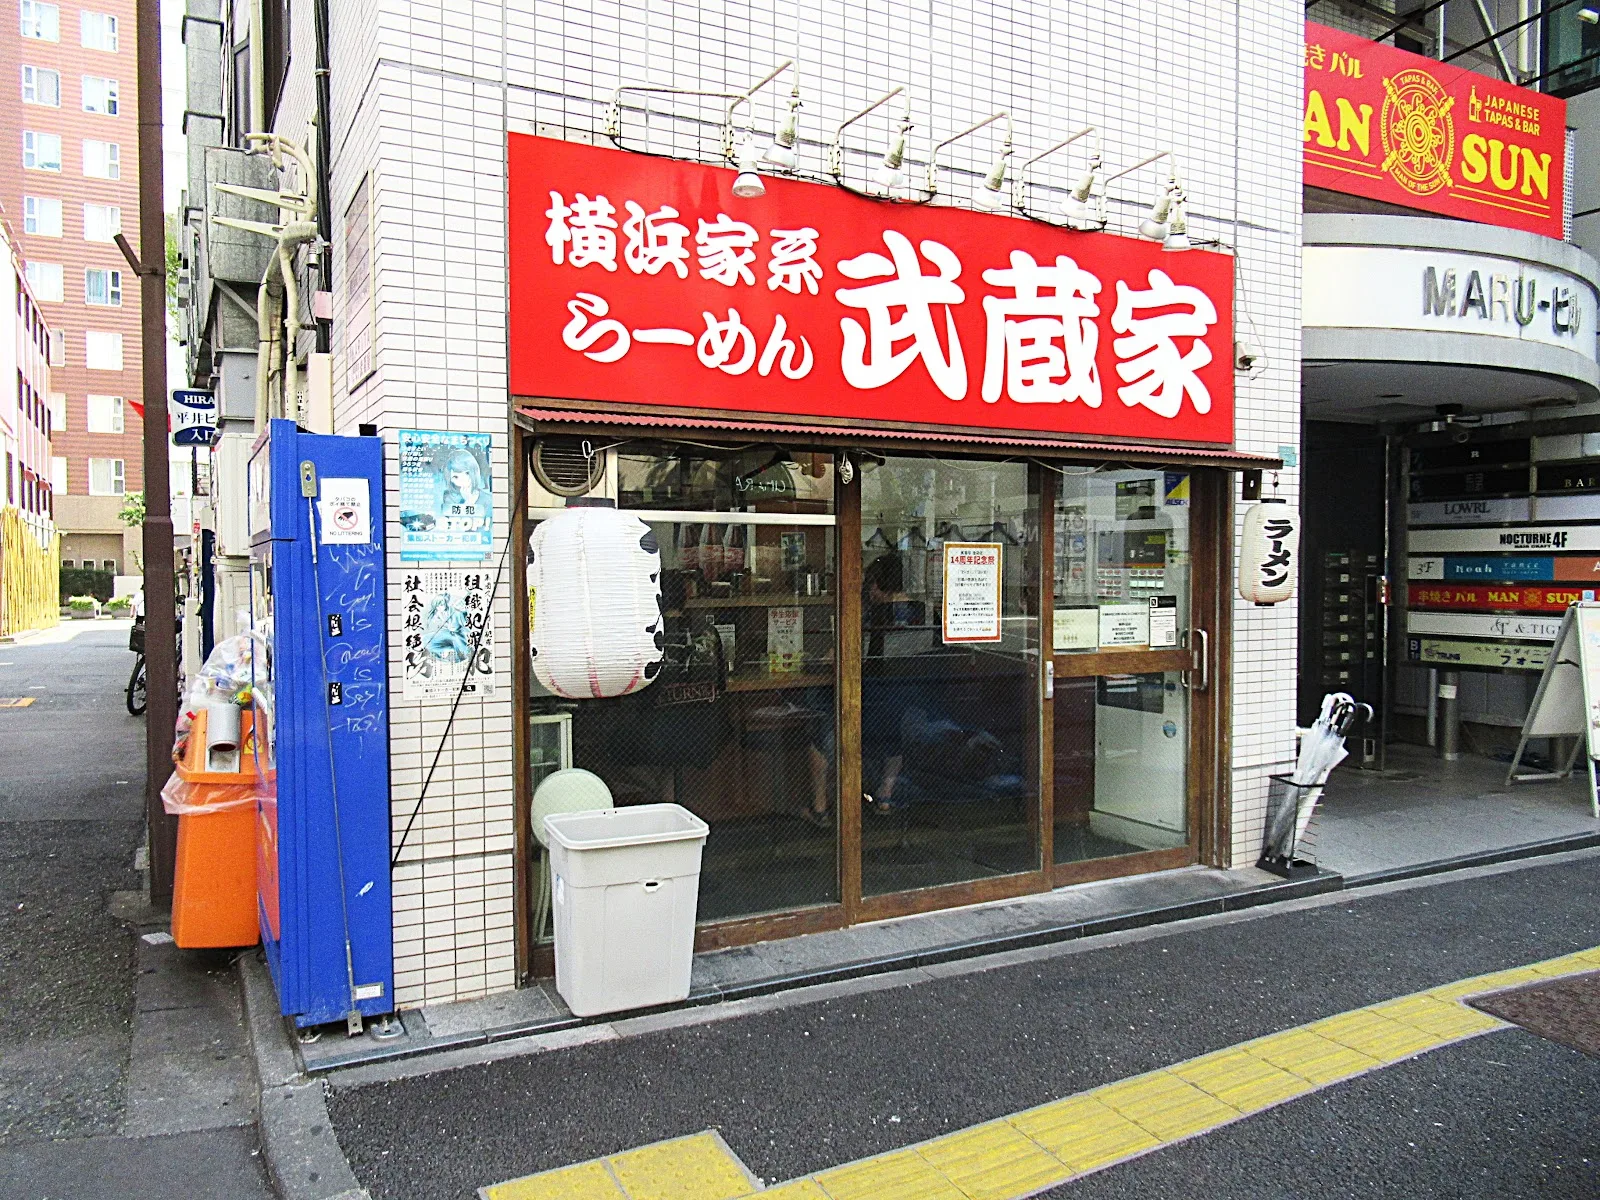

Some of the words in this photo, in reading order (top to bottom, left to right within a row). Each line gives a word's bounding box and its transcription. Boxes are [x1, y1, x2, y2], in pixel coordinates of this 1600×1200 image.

[1304, 43, 1364, 79] きバル
[1484, 94, 1540, 121] JAPANESE
[1484, 109, 1514, 130] TAPAS
[1514, 119, 1522, 131] &
[1522, 120, 1540, 137] BAR
[1461, 133, 1552, 200] SUN
[545, 190, 824, 295] 横浜家系
[562, 292, 814, 380] らーめん
[835, 229, 1218, 418] 武蔵家
[1260, 519, 1294, 587] ラーメン
[1499, 533, 1551, 544] NOCTURNE
[1552, 531, 1568, 548] 4F
[1416, 561, 1434, 575] 3F
[1488, 591, 1520, 603] MAN
[1547, 592, 1579, 604] SUN
